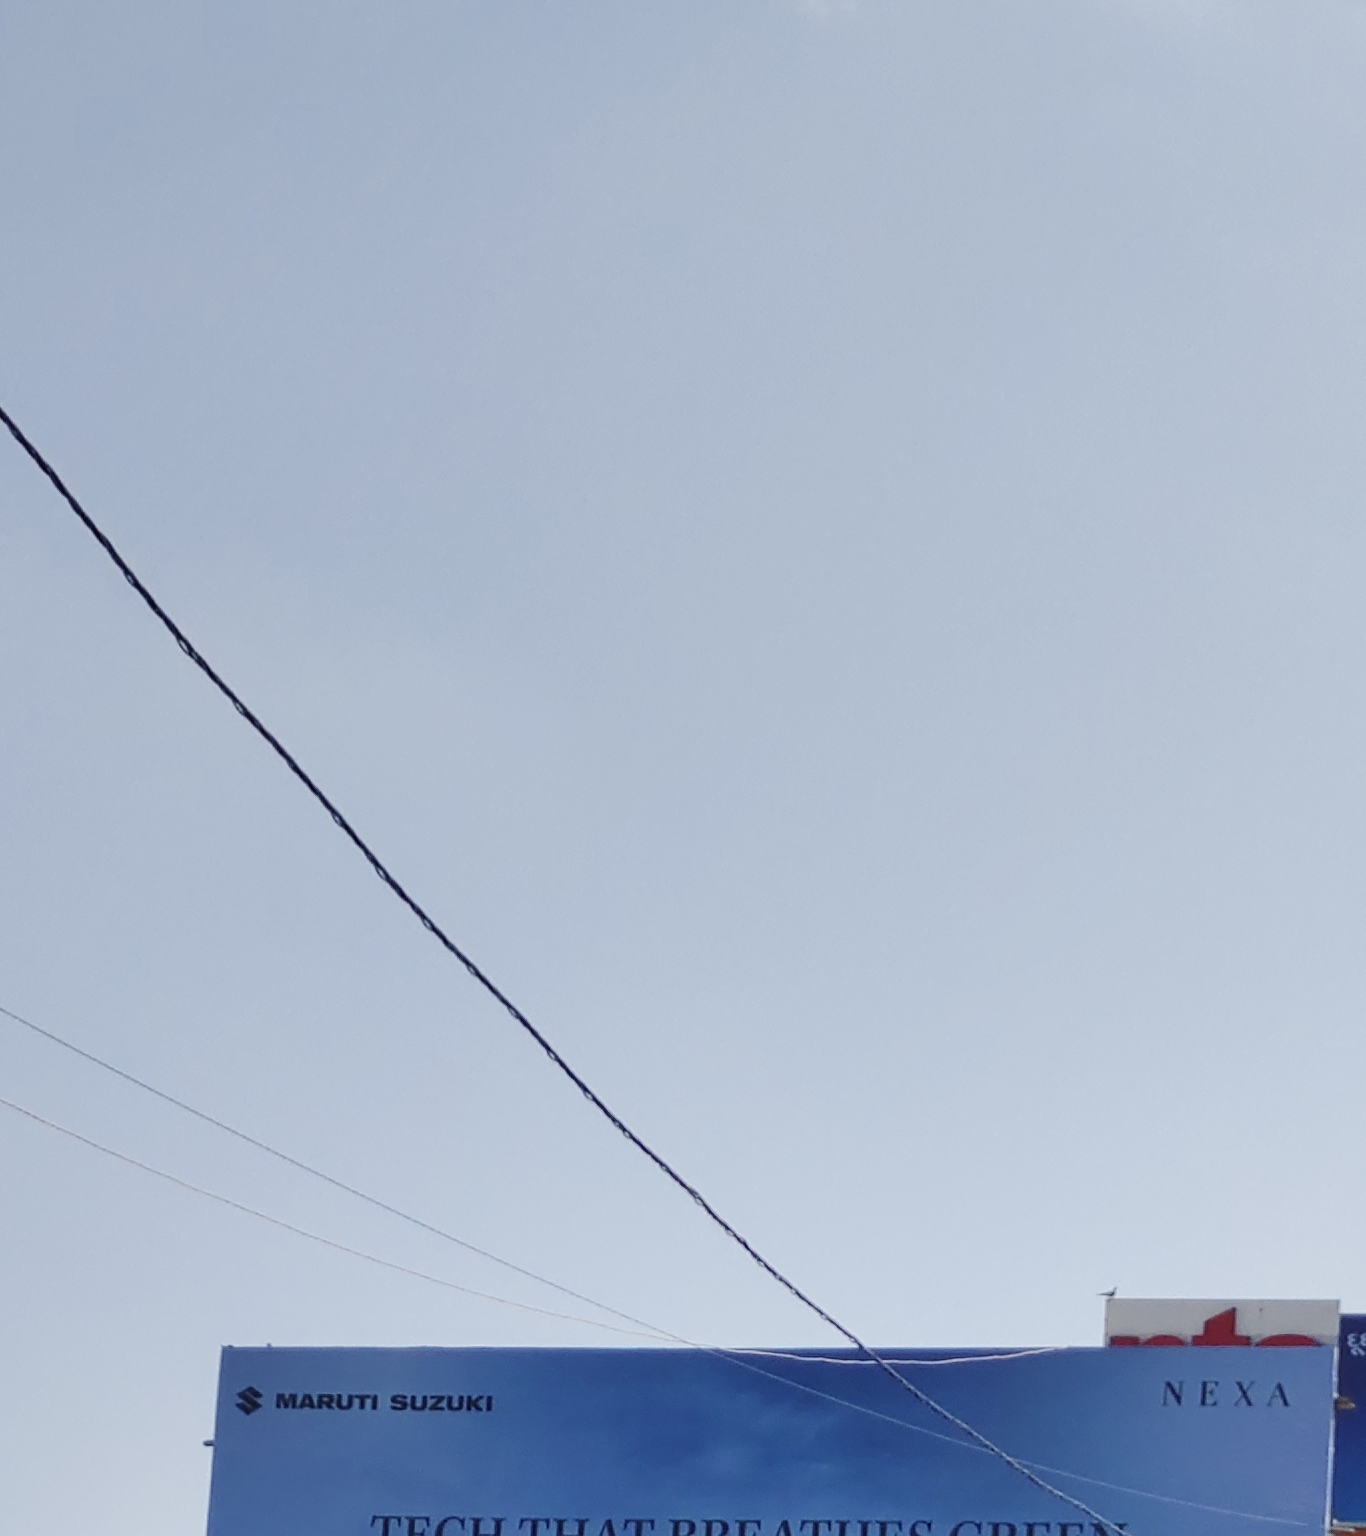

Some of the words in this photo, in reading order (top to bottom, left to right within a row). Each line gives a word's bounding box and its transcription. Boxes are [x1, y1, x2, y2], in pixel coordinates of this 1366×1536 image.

[275, 1392, 378, 1412] MARUTI
[390, 1393, 494, 1413] SUZUKI
[1161, 1379, 1292, 1408] NEXA
